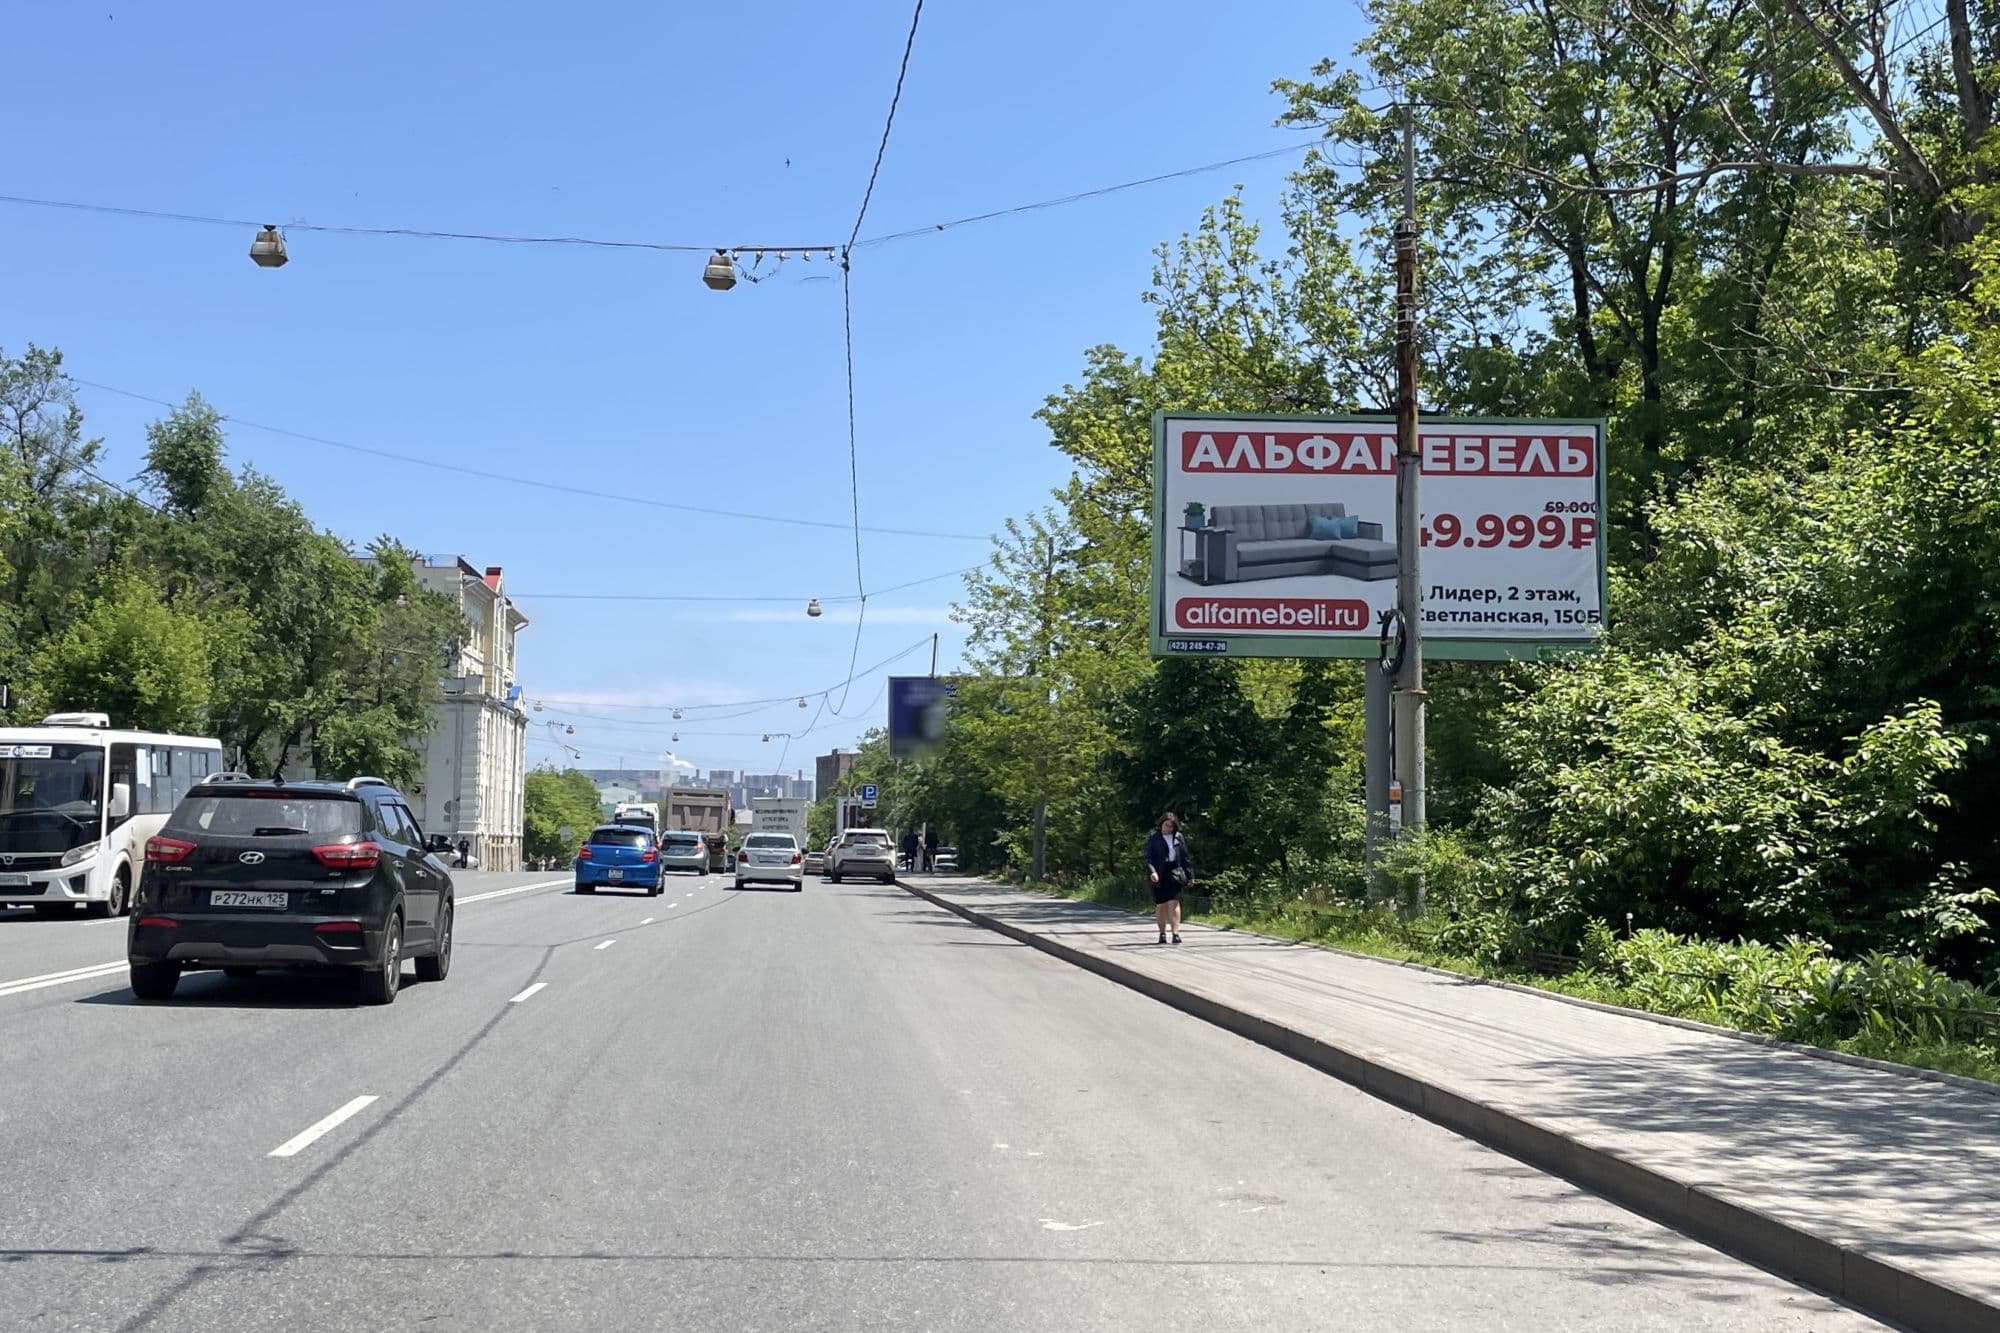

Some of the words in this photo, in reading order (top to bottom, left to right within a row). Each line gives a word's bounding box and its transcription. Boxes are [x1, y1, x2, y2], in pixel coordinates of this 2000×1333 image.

[1429, 586, 1502, 603] Лидер,
[1508, 586, 1519, 601] 2
[1525, 588, 1581, 604] этаж,
[1185, 599, 1360, 626] alfamebeli.ru
[865, 786, 875, 799] P
[266, 893, 286, 903] 125
